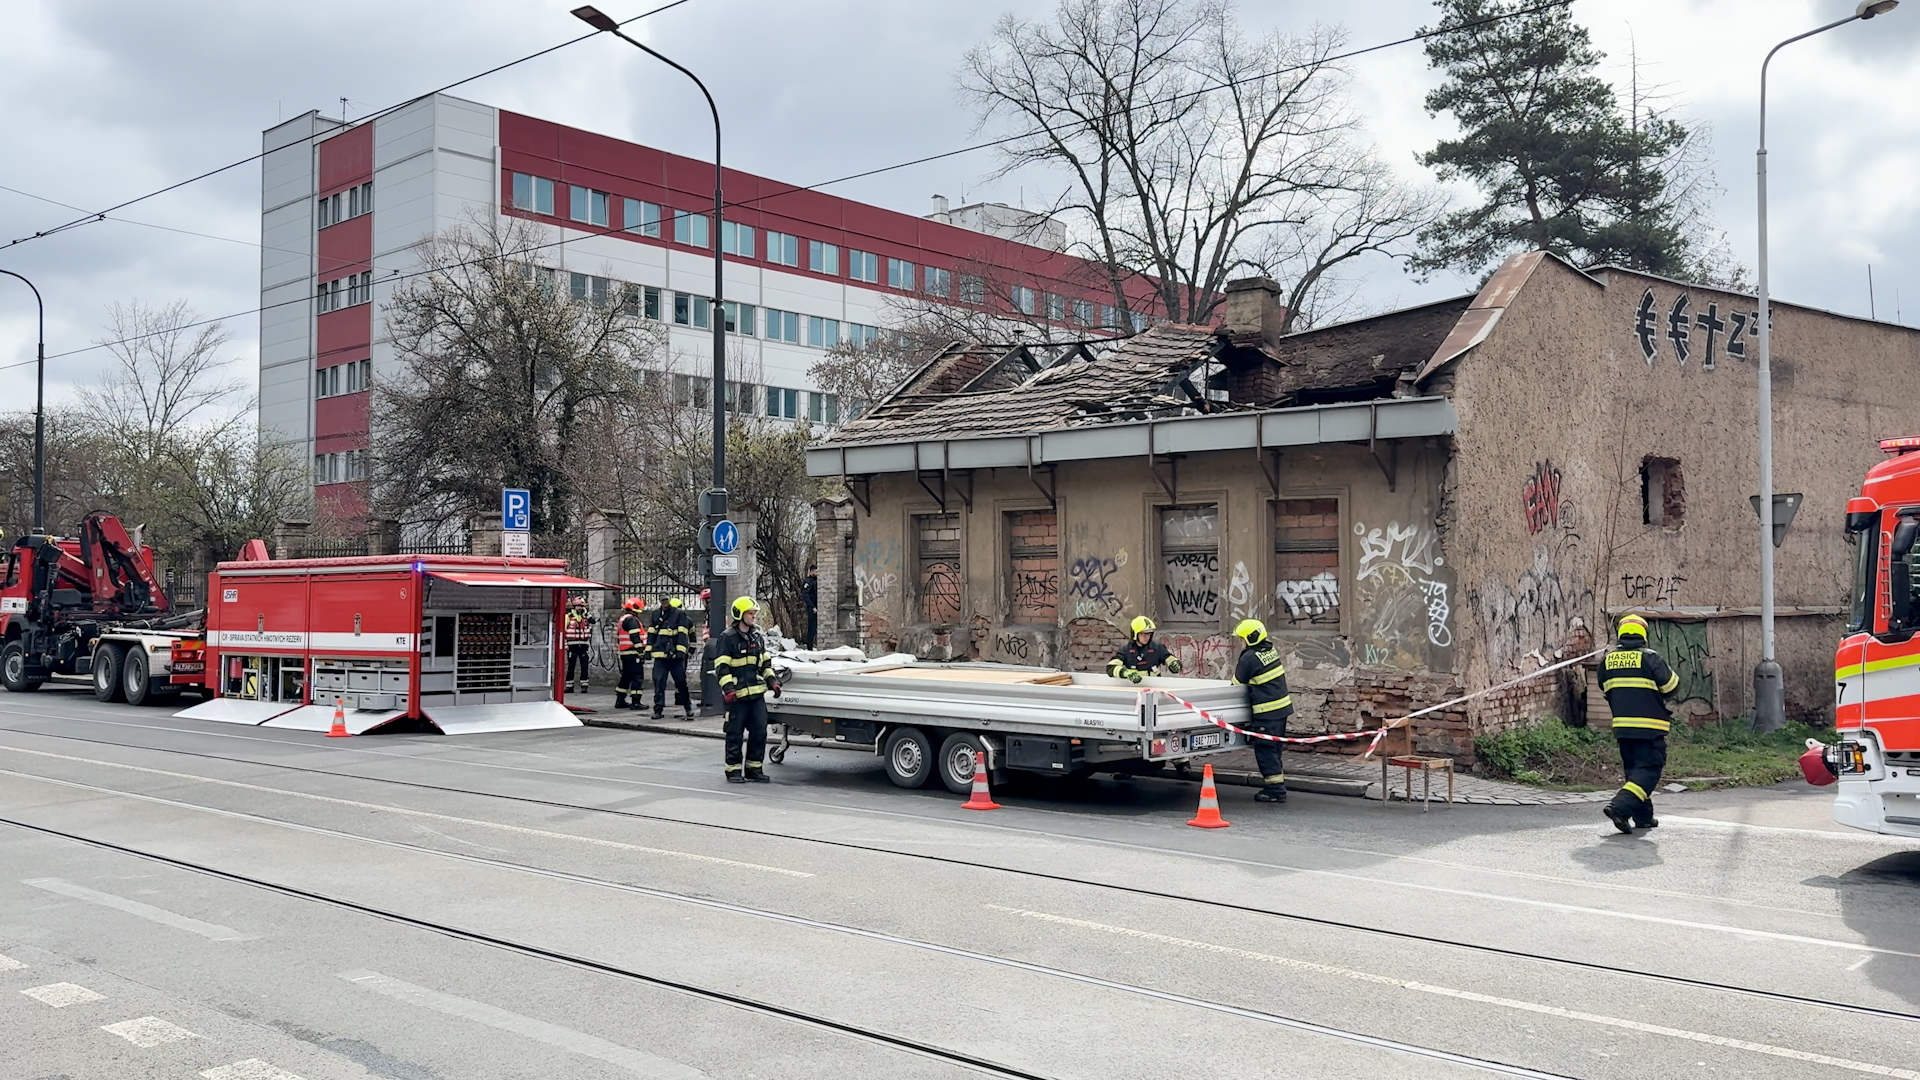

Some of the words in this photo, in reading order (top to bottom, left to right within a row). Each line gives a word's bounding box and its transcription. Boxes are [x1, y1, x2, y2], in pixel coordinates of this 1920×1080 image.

[508, 494, 525, 518] P
[396, 637, 406, 645] KTE
[196, 649, 204, 660] 7
[1608, 660, 1637, 669] PRAHA
[1837, 682, 1847, 704] 7
